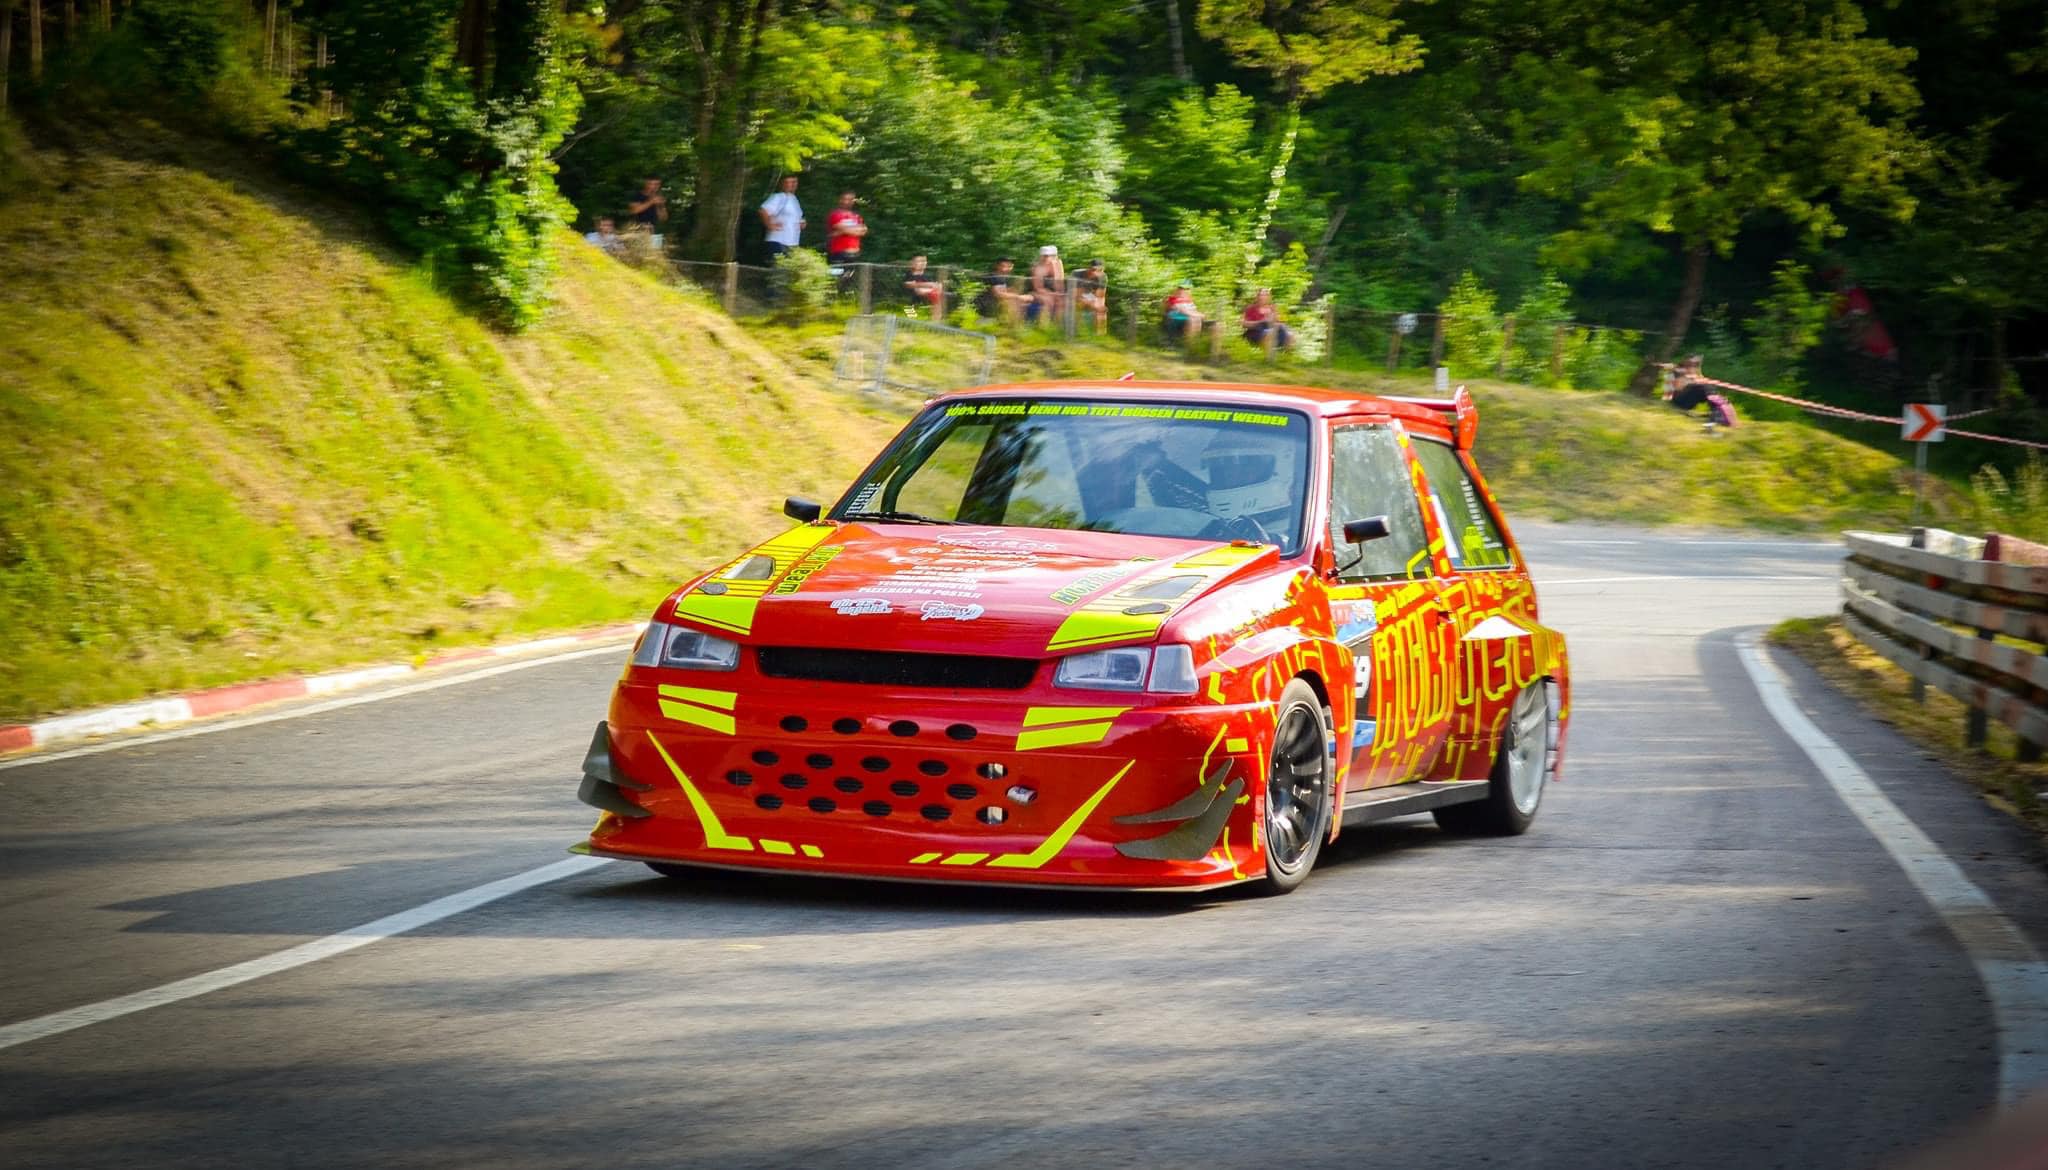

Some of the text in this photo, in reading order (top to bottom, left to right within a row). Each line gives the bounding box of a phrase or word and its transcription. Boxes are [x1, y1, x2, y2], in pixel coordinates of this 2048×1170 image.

[946, 406, 977, 417] 100%
[1028, 405, 1063, 415] DENN
[1061, 406, 1089, 415] NUR
[1090, 407, 1121, 417] TOTE
[1174, 409, 1233, 421] BEATMET
[1232, 412, 1289, 426] WERDEN
